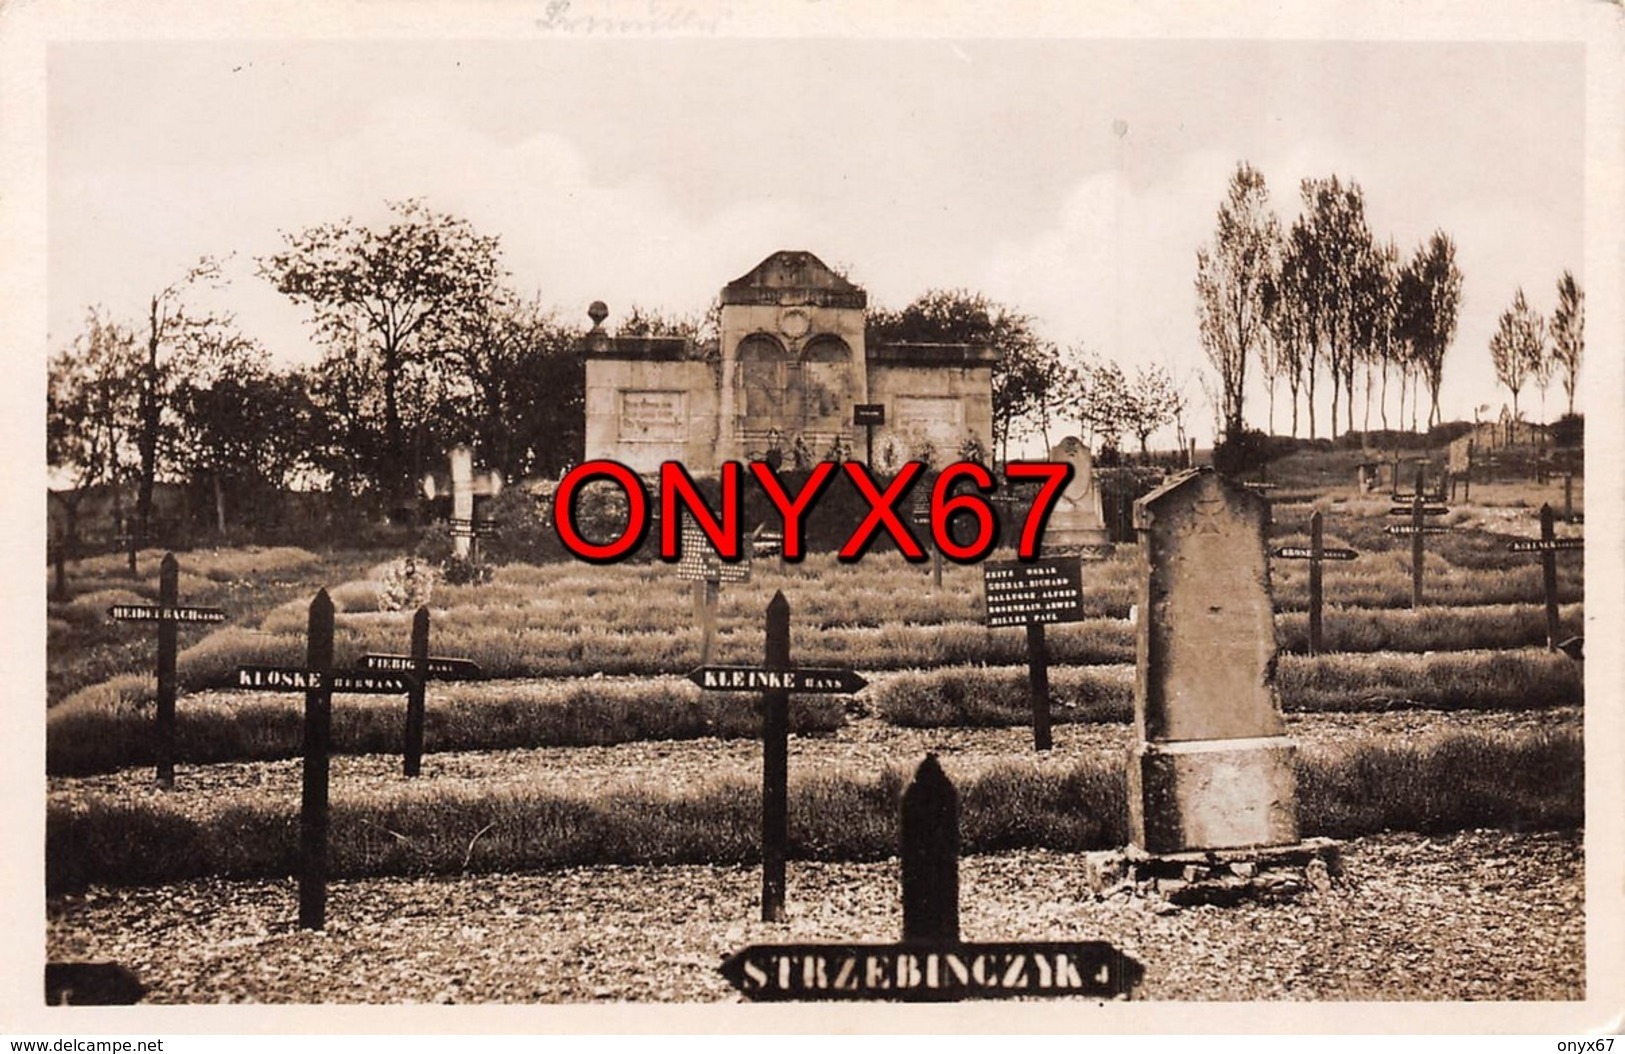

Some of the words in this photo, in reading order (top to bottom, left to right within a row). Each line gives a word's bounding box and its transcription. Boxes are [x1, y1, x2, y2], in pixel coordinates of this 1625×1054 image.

[1029, 577, 1069, 588] RICHARD
[1042, 589, 1077, 599] ALFRED
[1034, 612, 1058, 622] PAUL
[368, 657, 416, 671] FIEBIG
[239, 669, 321, 688] KLOSKE
[335, 678, 403, 689] HERMANN
[705, 671, 796, 688] KLEINKE
[804, 678, 843, 689] HANS
[743, 953, 1083, 989] STRZEBINCZYK
